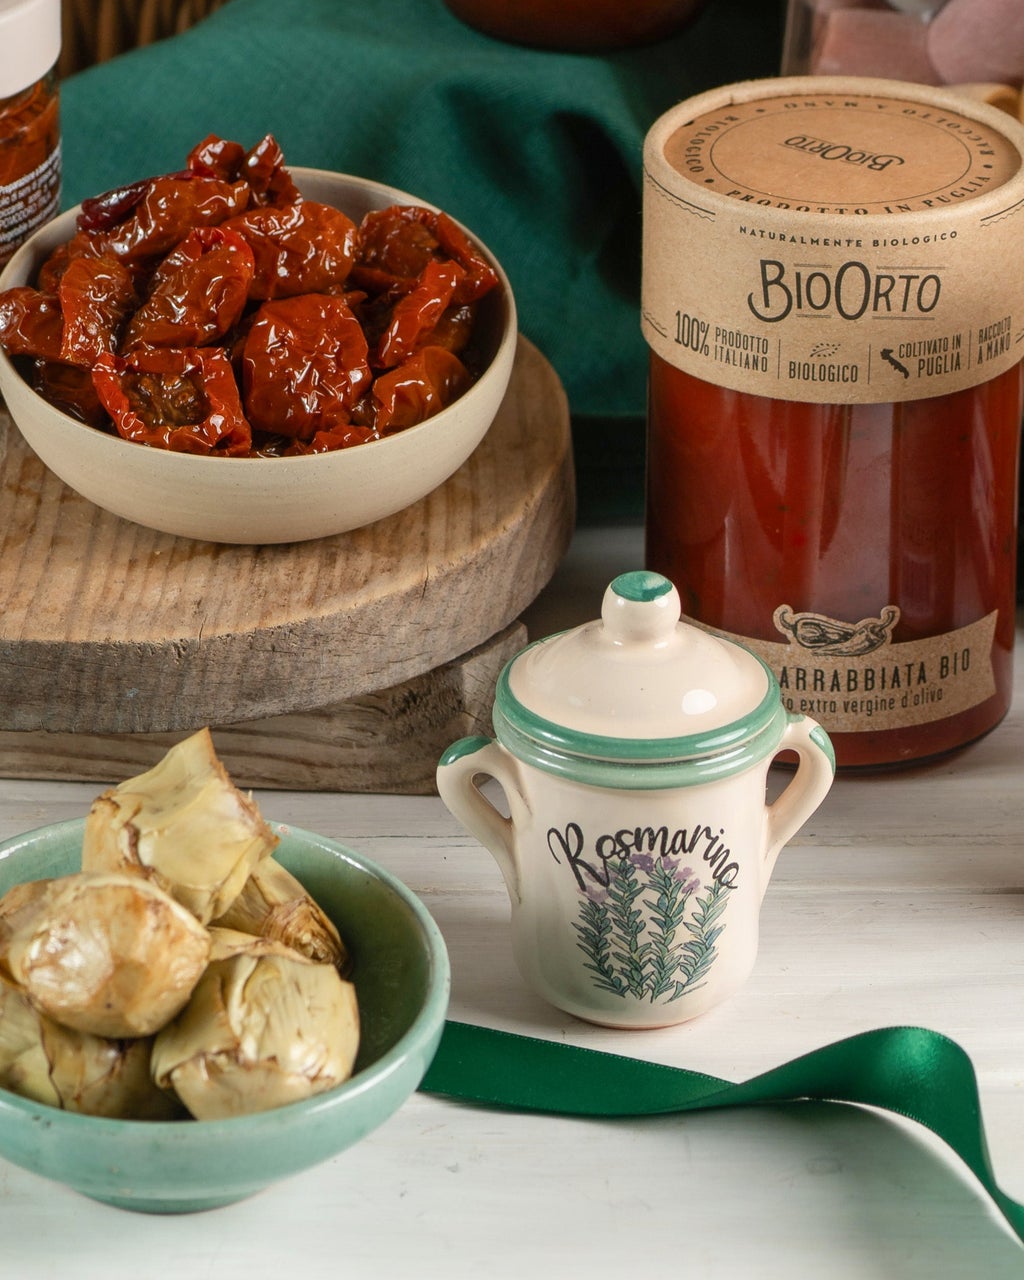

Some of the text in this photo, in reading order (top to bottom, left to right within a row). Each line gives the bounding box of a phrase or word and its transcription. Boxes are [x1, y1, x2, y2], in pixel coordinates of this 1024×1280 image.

[725, 189, 869, 216] PRODOTTO
[924, 174, 991, 208] PUGLIA
[739, 225, 959, 249] NATURALMENTE BIOLOGICO
[674, 310, 710, 357] 100%
[715, 327, 769, 355] PRODOTTO
[977, 316, 1012, 343] RACCOLTO
[714, 345, 769, 373] ITALIANO
[898, 334, 962, 359] COLTIVATO IN
[987, 334, 1012, 359] MANO
[788, 360, 860, 383] BIOLOGICO
[917, 351, 962, 379] PUGLIA
[940, 648, 971, 679] BIO
[800, 696, 837, 713] extra
[843, 695, 895, 717] vergine
[901, 687, 944, 708] d'oliva
[546, 822, 743, 893] Rosmarino
